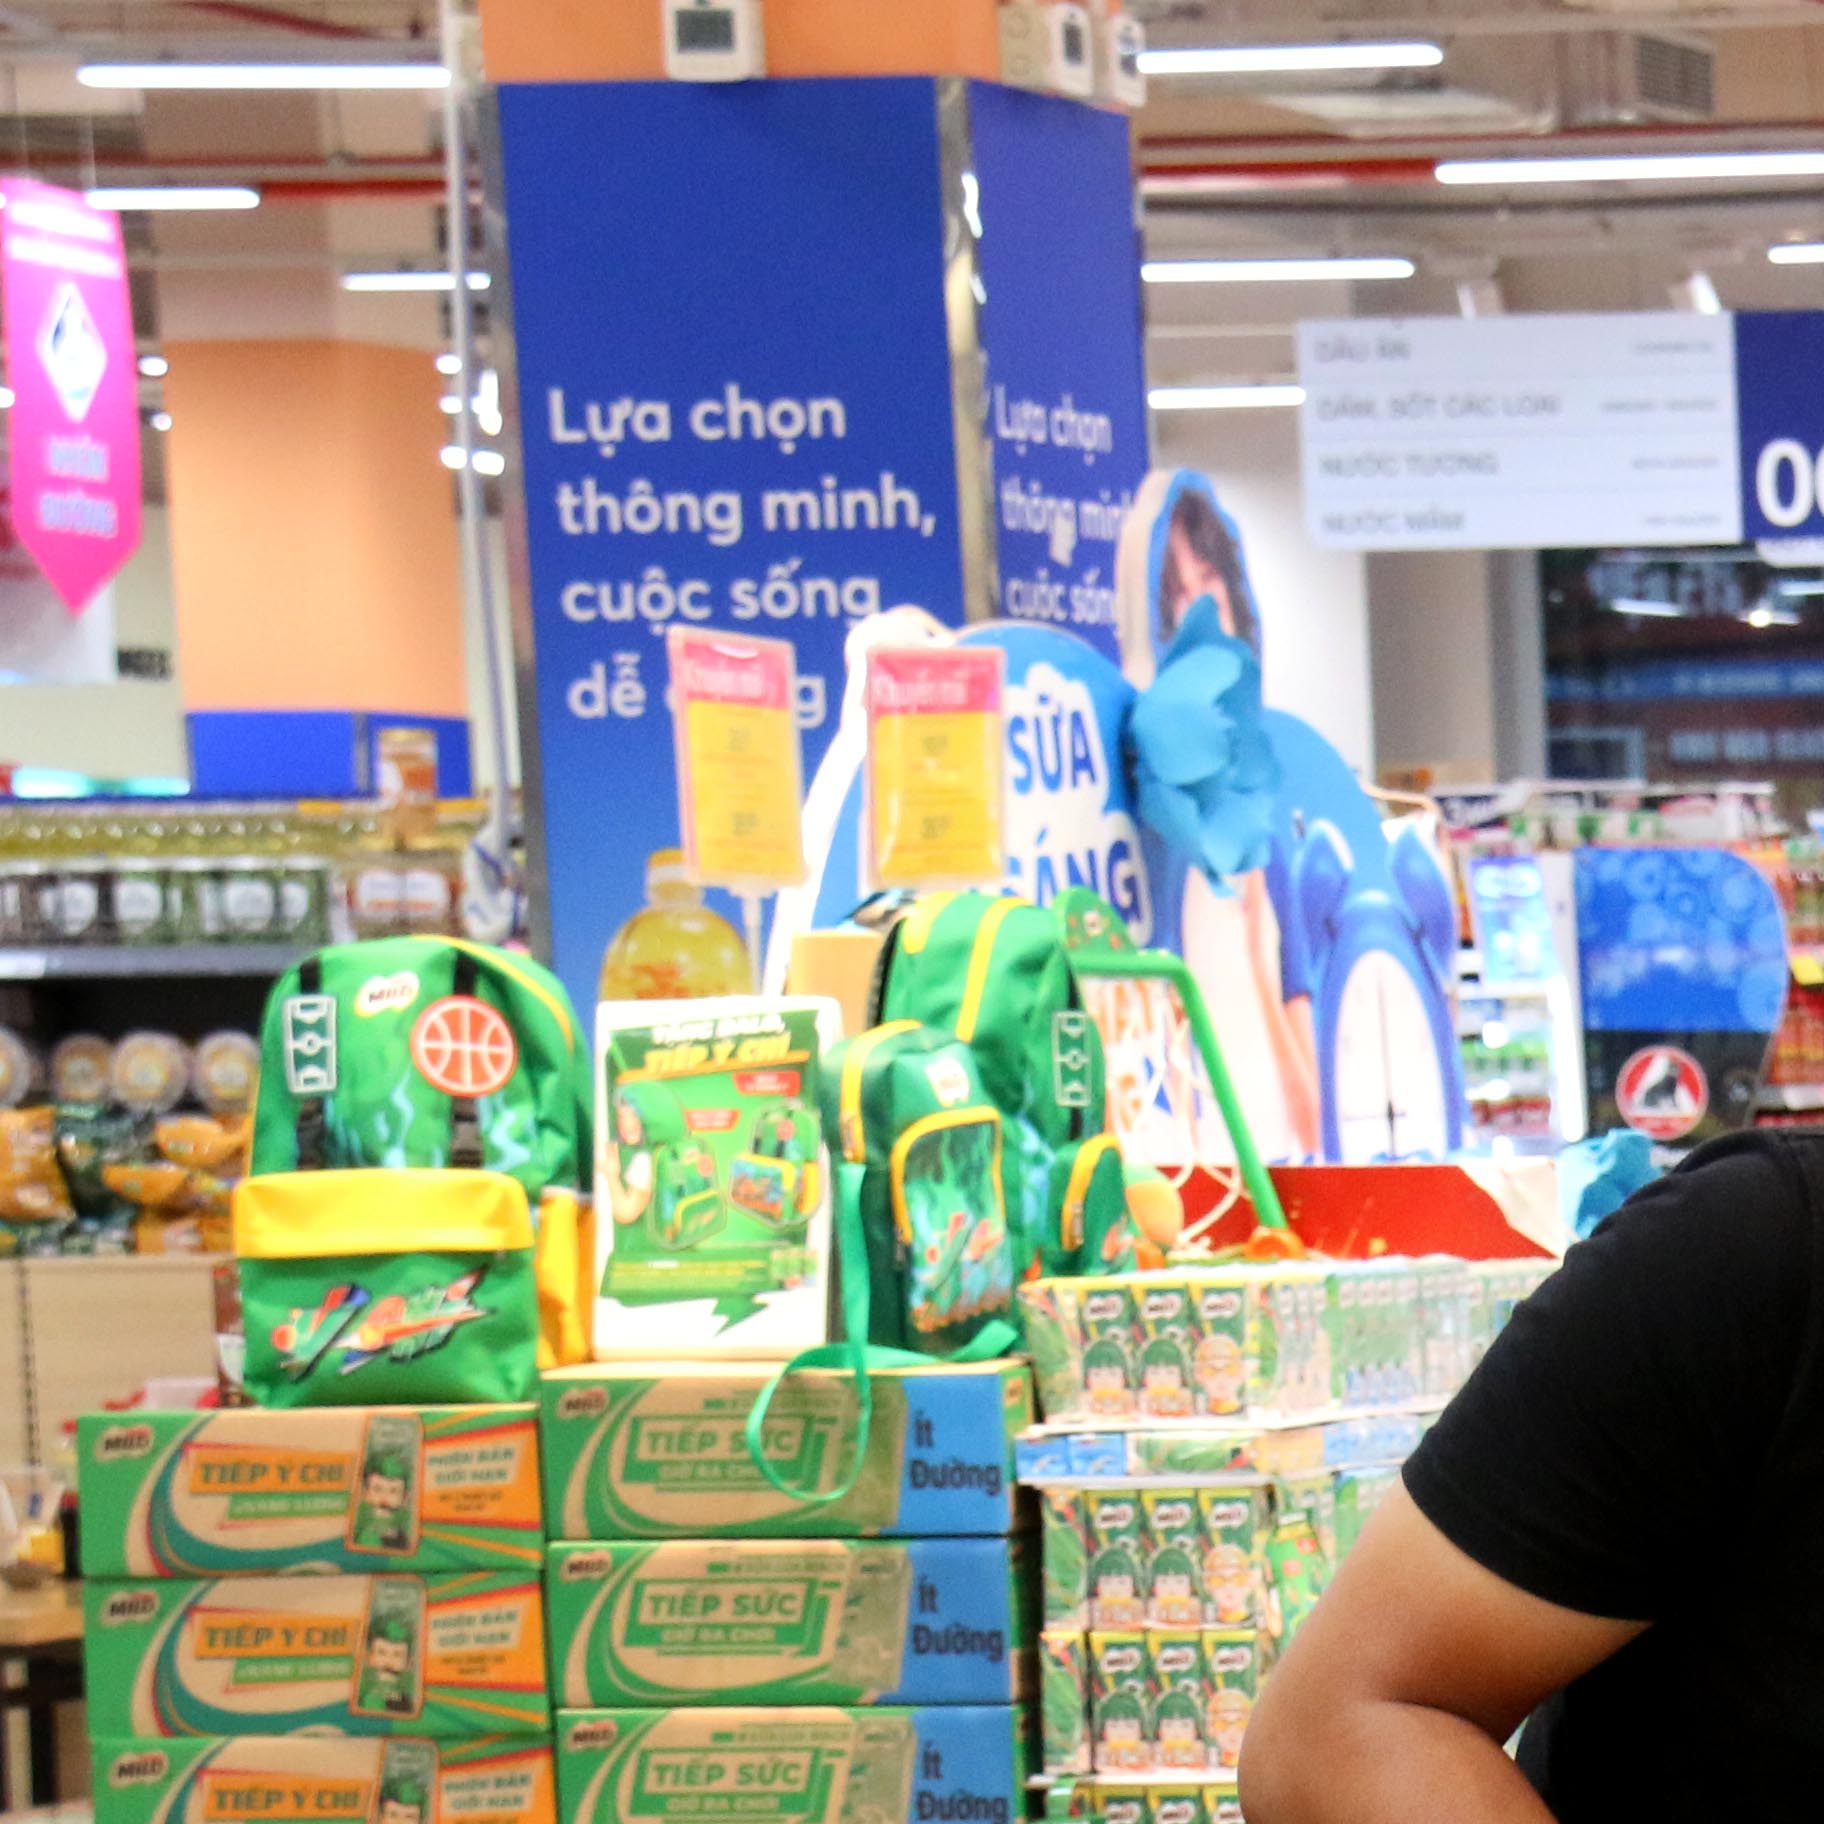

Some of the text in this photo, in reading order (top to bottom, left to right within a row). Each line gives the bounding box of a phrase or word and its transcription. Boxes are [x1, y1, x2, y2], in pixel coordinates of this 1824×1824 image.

[549, 384, 847, 457] Lựa chọn
[994, 386, 1113, 463] Lựa chọn
[556, 474, 937, 546] thông minh,
[562, 555, 881, 637] cuộc sống
[1005, 571, 1068, 622] cuộc
[566, 652, 646, 720] dễ
[1009, 688, 1099, 797] SỮA
[1004, 828, 1148, 921] ÁNG
[646, 1422, 719, 1454] TIẾP
[914, 1410, 934, 1449] Ít
[203, 1456, 269, 1485] TIẾP
[911, 1457, 1000, 1495] Đường
[646, 1585, 798, 1618] TIẾP SỨC
[918, 1576, 938, 1614] Ít
[206, 1620, 274, 1649] TIẾP
[913, 1623, 1003, 1663] Đường
[652, 1753, 801, 1787] TIẾP SỨC
[922, 1740, 943, 1780] Ít
[213, 1782, 283, 1812] TIẾP
